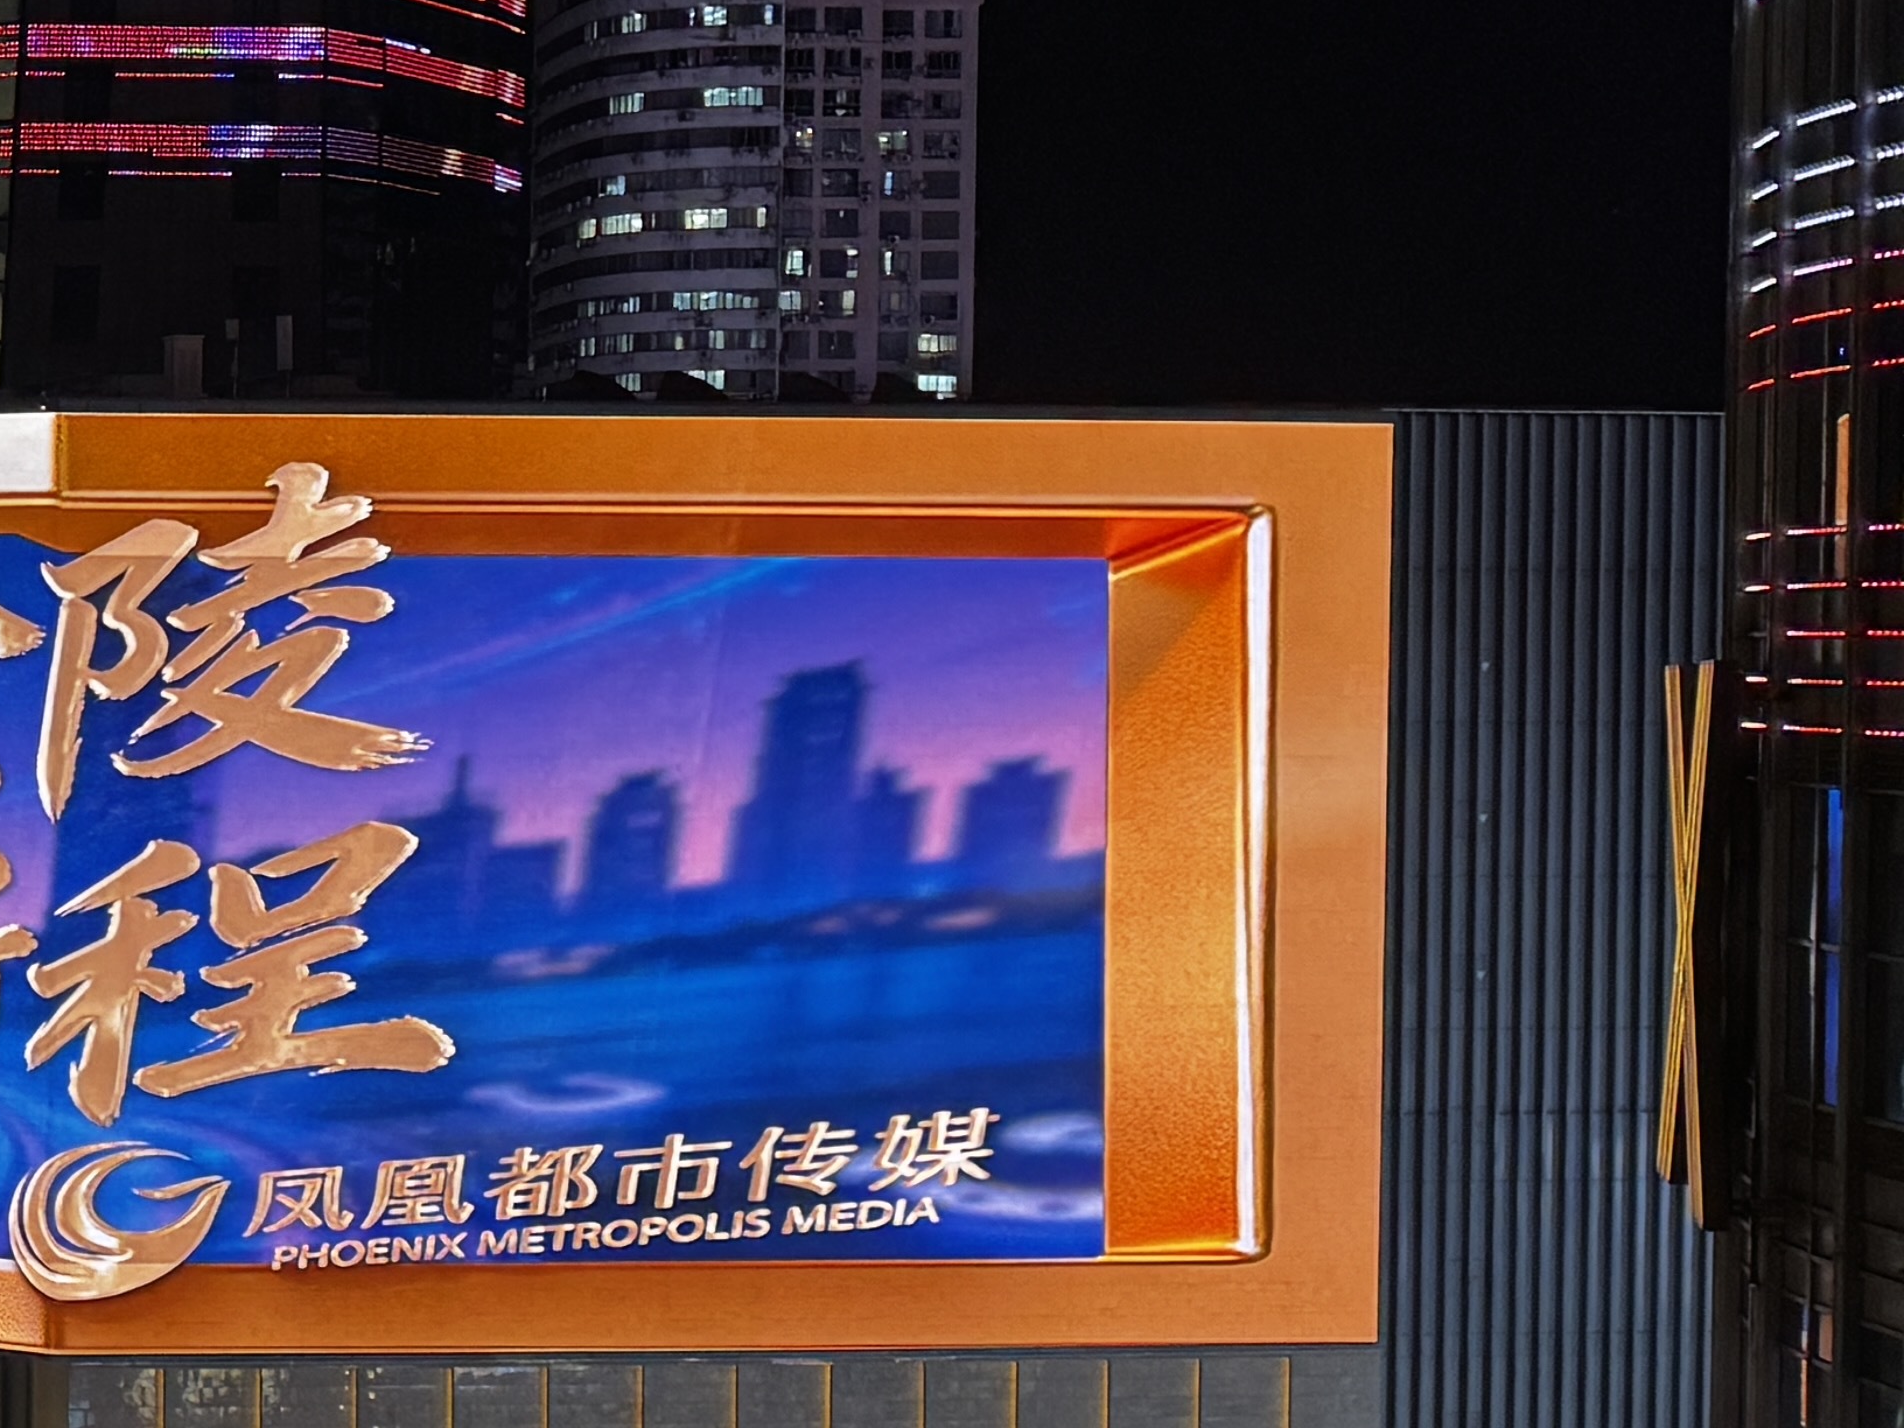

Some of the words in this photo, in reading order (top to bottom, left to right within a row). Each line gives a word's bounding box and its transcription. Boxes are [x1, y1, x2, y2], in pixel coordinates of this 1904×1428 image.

[243, 1106, 998, 1237] 凤凰都市传媒
[271, 1231, 467, 1272] PHOENIX
[478, 1211, 770, 1260] METROPOLIS
[782, 1195, 940, 1236] MEDIA
